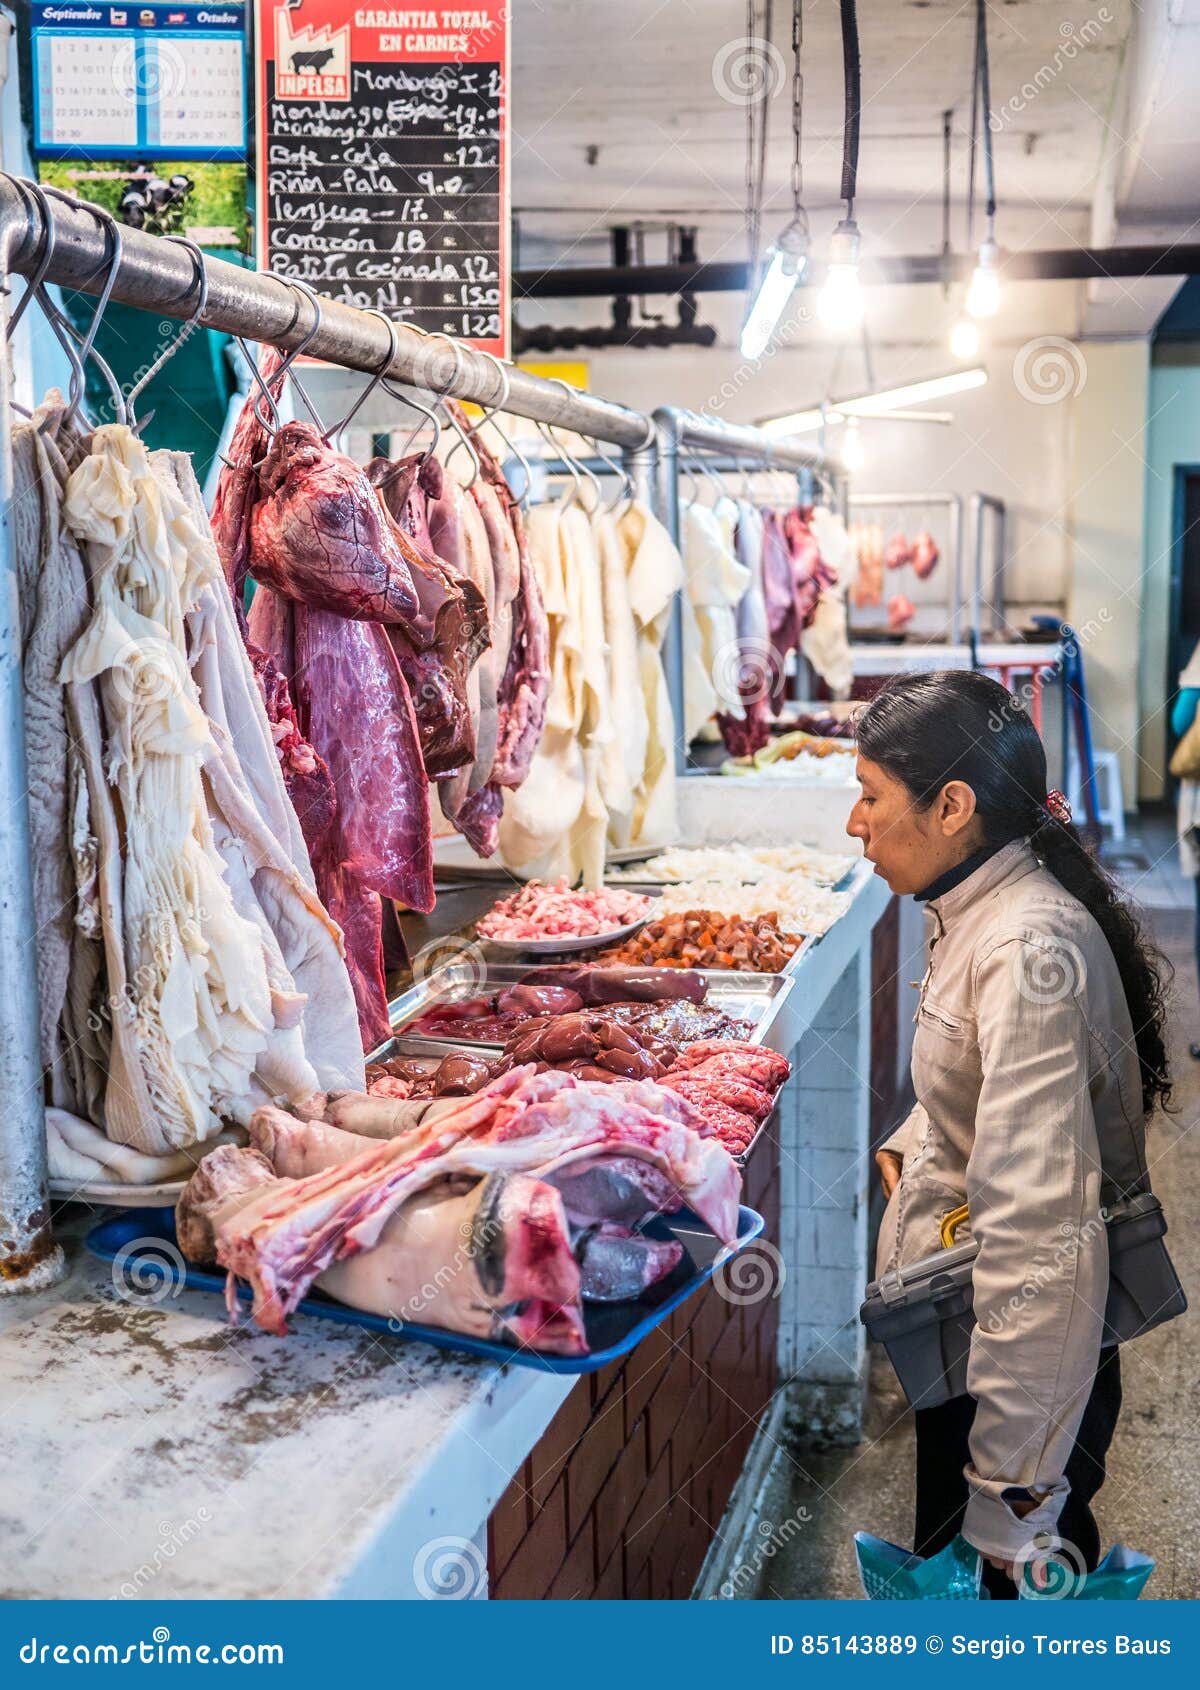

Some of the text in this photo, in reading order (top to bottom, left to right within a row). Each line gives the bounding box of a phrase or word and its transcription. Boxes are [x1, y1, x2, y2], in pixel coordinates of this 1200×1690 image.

[42, 6, 103, 21] Septiembre
[354, 10, 491, 28] GARANTIA TOTAL
[379, 34, 468, 52] EN CARNES
[280, 75, 346, 96] INPELSA
[271, 227, 376, 253] Corazón
[392, 229, 427, 253] 18
